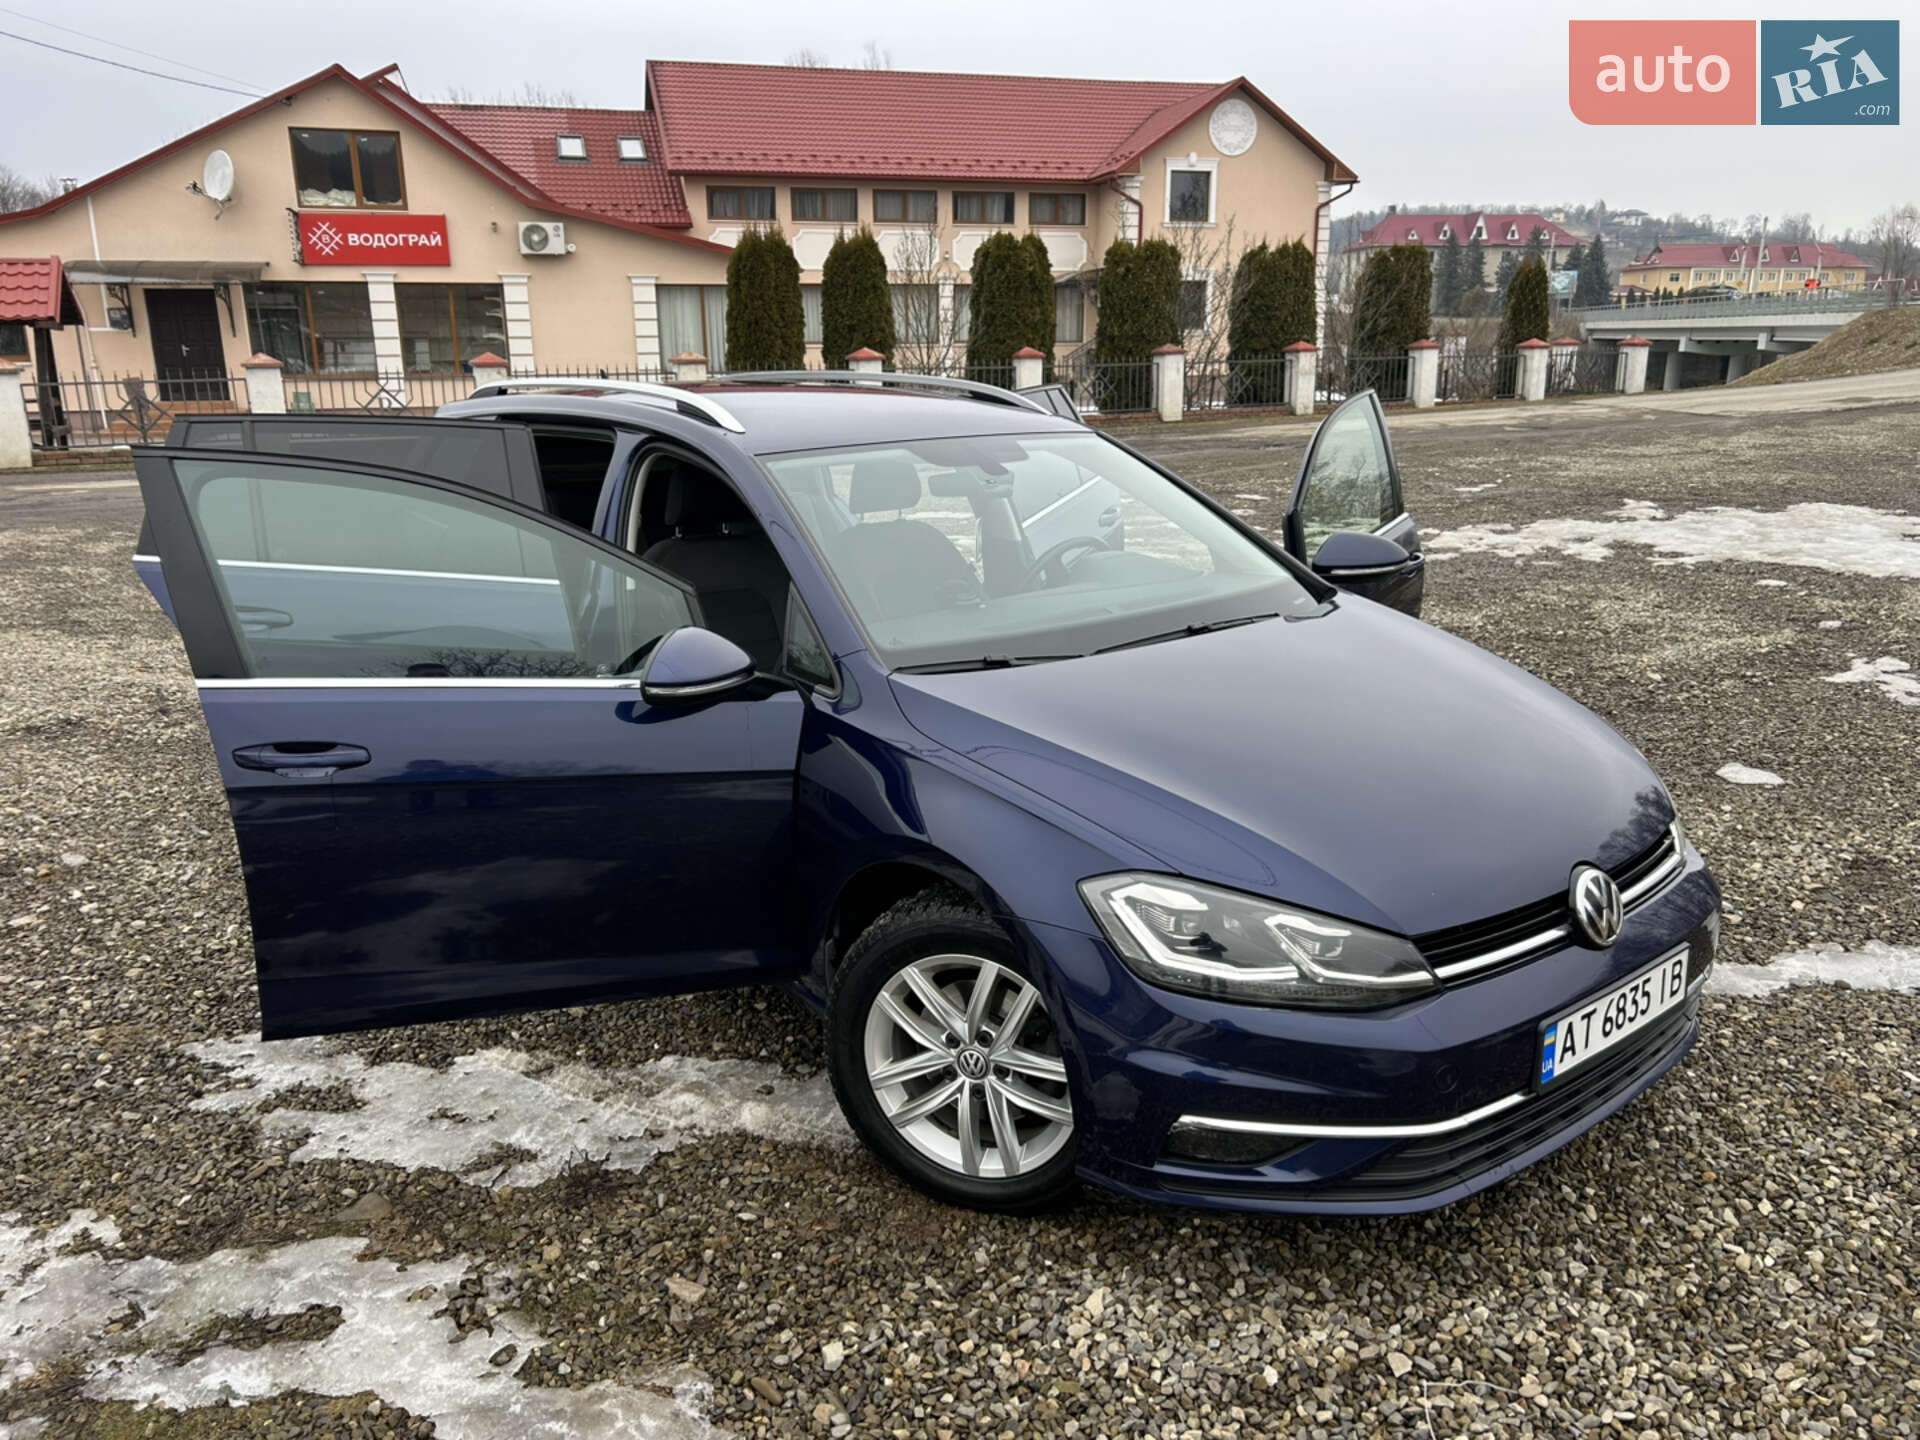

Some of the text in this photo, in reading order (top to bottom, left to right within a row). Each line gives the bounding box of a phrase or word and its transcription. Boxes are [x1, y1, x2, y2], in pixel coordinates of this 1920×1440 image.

[347, 231, 442, 248] ВОДОГРАЙ
[1559, 959, 1683, 1064] AT 6835 IB
[1541, 1058, 1553, 1073] UA
